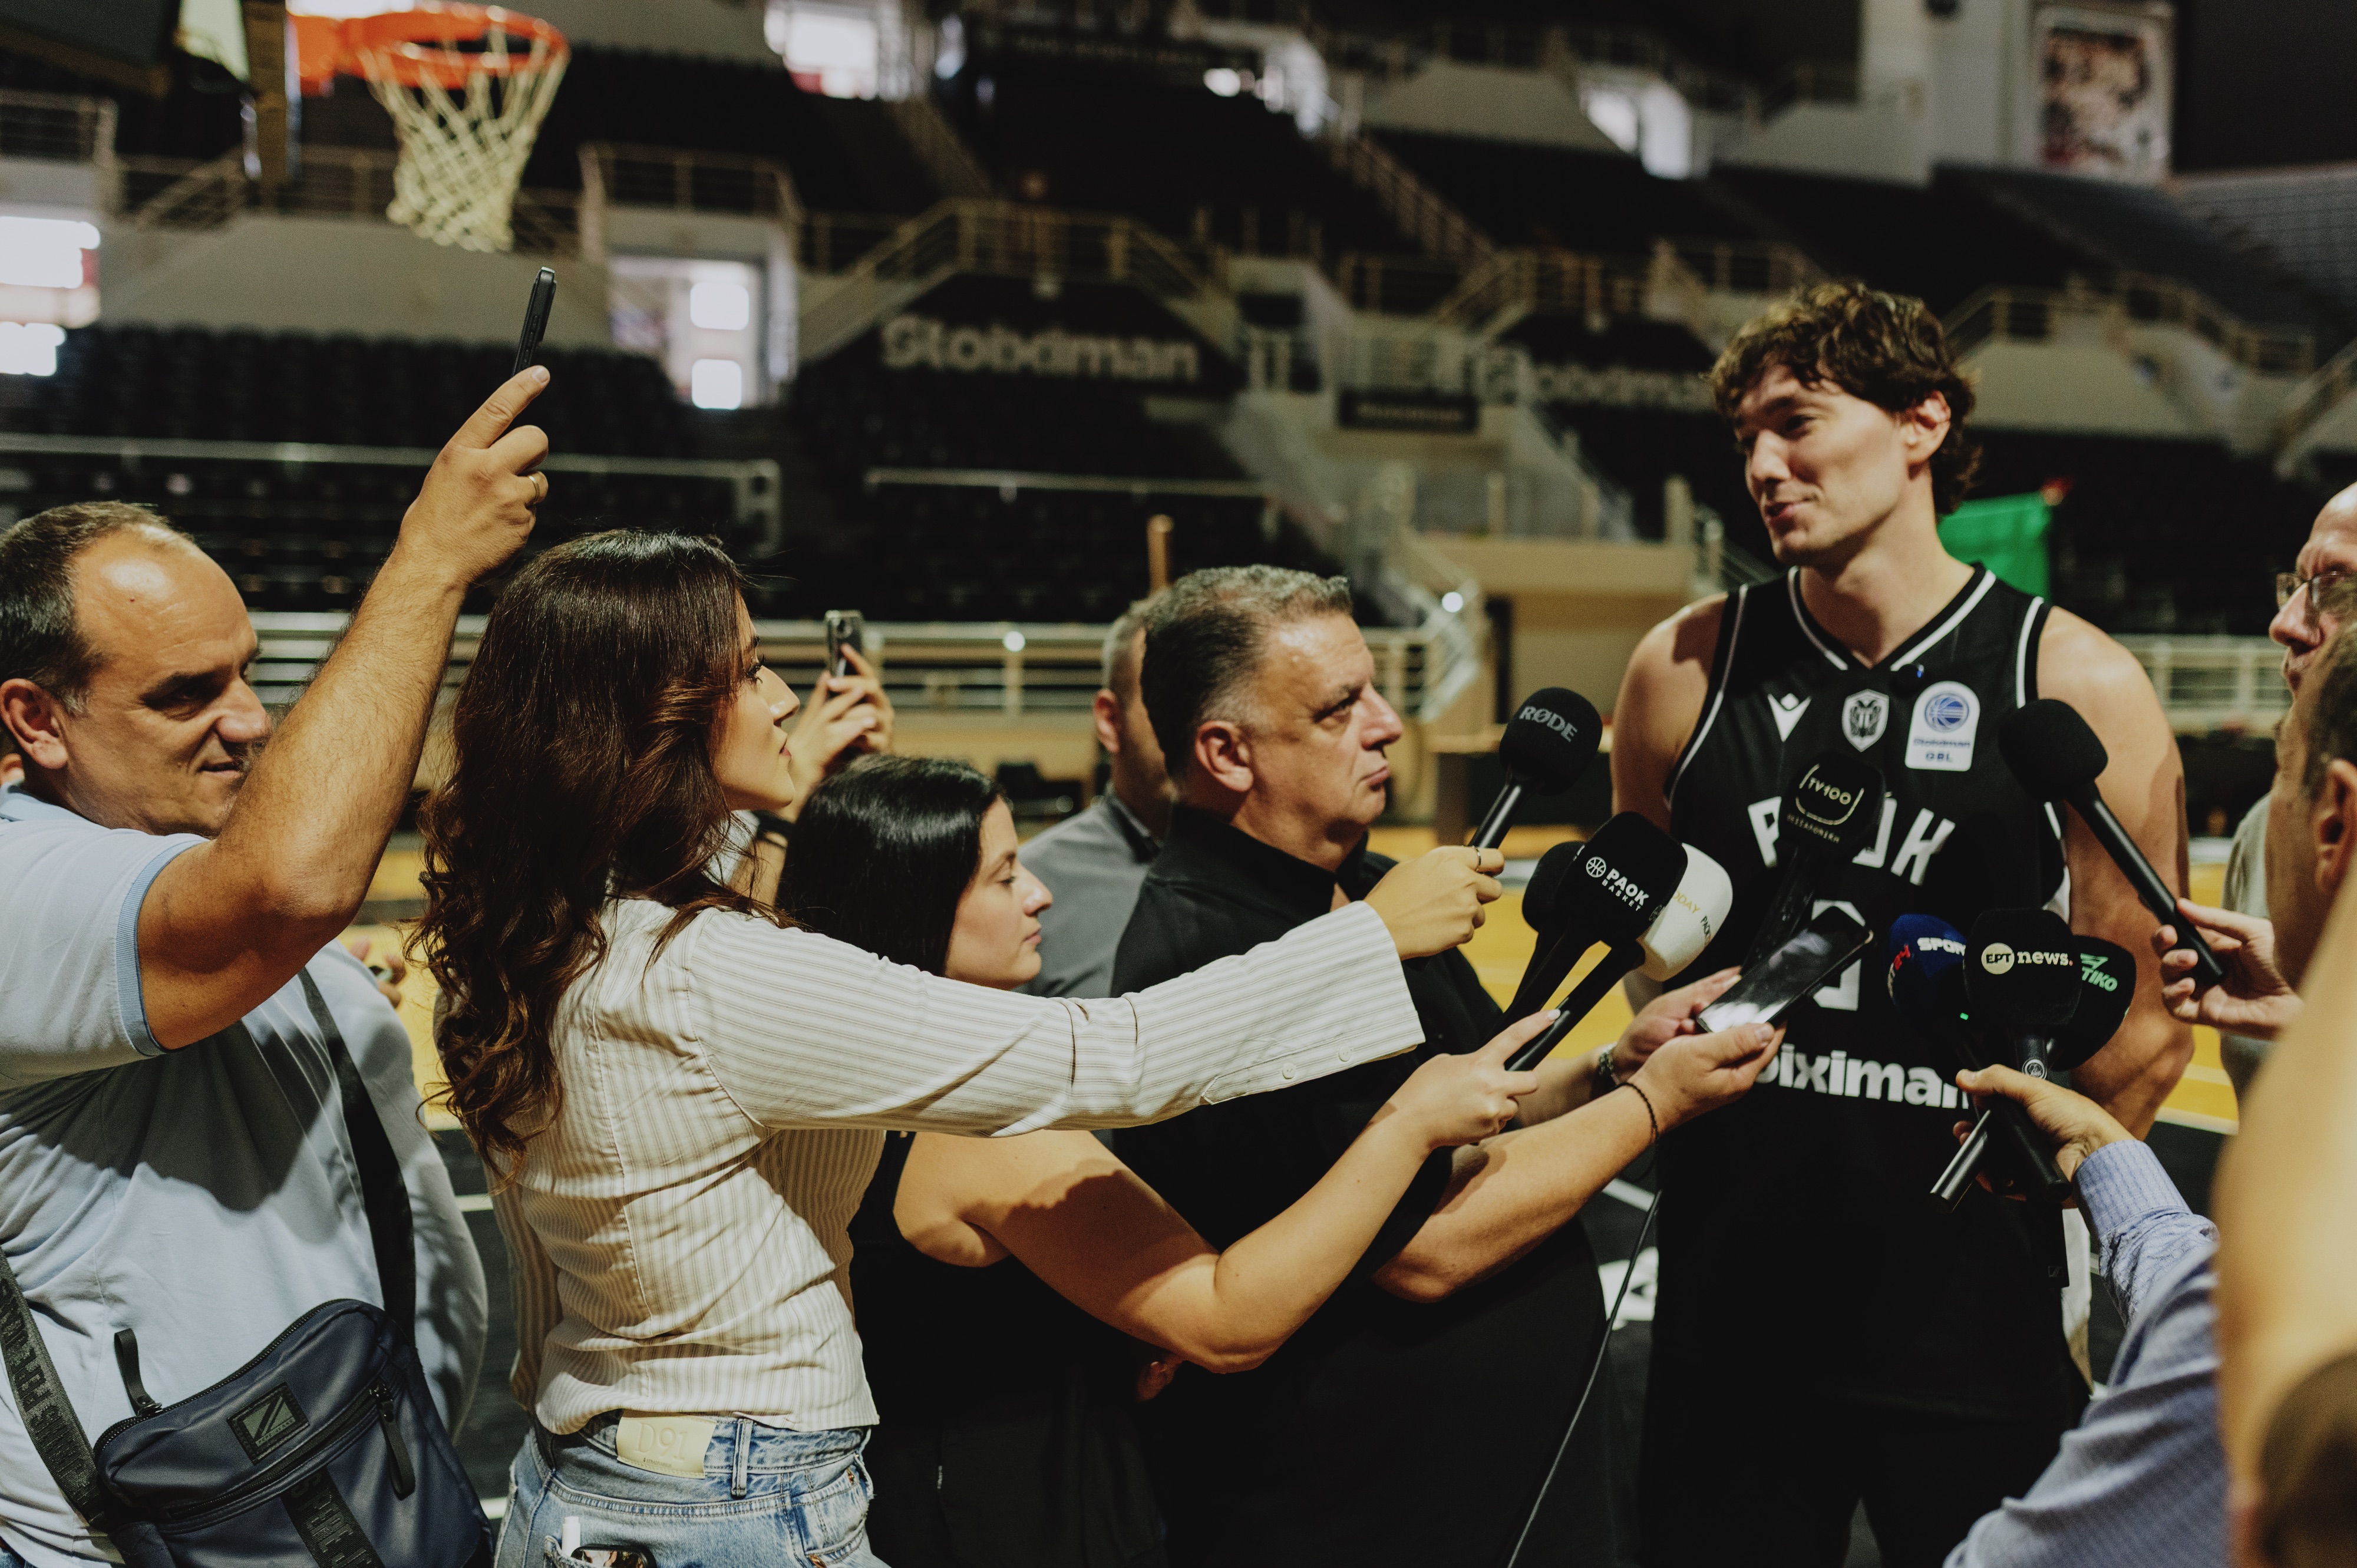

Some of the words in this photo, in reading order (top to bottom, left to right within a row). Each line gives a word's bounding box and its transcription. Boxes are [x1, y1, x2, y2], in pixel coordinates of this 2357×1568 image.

[1519, 705, 1578, 742] RØDE
[1808, 777, 1851, 805] TV100
[1748, 797, 1956, 886] POK
[1602, 879, 1641, 911] BASKET
[1606, 868, 1649, 906] PAOK
[1673, 889, 1701, 915] ODAY
[1917, 937, 1966, 956] SPOR
[2018, 952, 2073, 966] news.
[635, 1423, 688, 1460] D91
